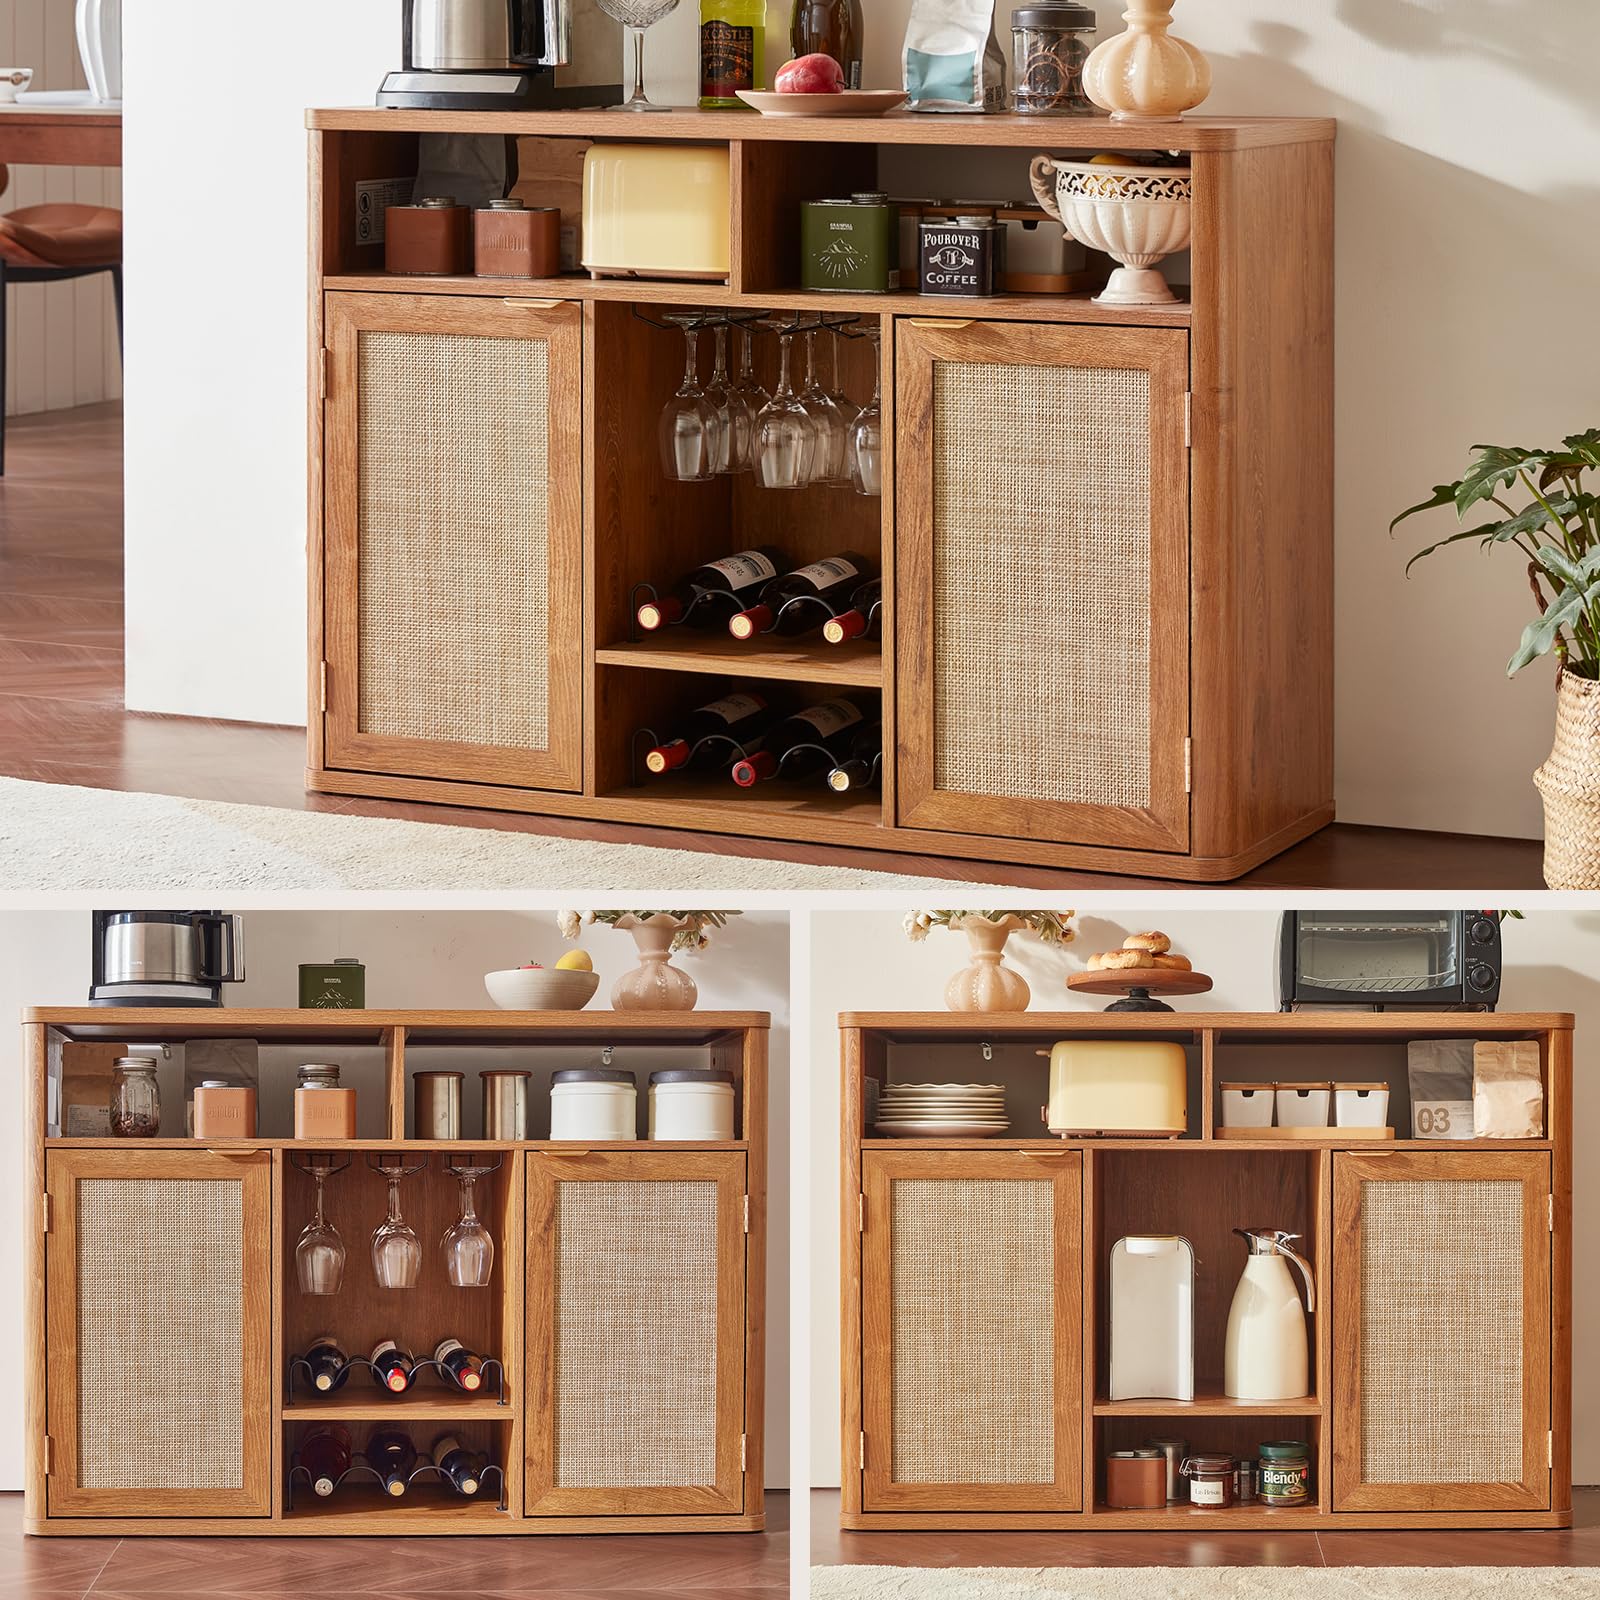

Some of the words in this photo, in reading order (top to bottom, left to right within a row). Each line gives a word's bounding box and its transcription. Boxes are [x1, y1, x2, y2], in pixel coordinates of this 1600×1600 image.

[711, 29, 752, 40] CASTLE
[924, 233, 980, 250] POUROVER
[926, 272, 977, 285] COFFEE
[1417, 1108, 1451, 1133] 03
[1263, 1470, 1300, 1485] Blendy
